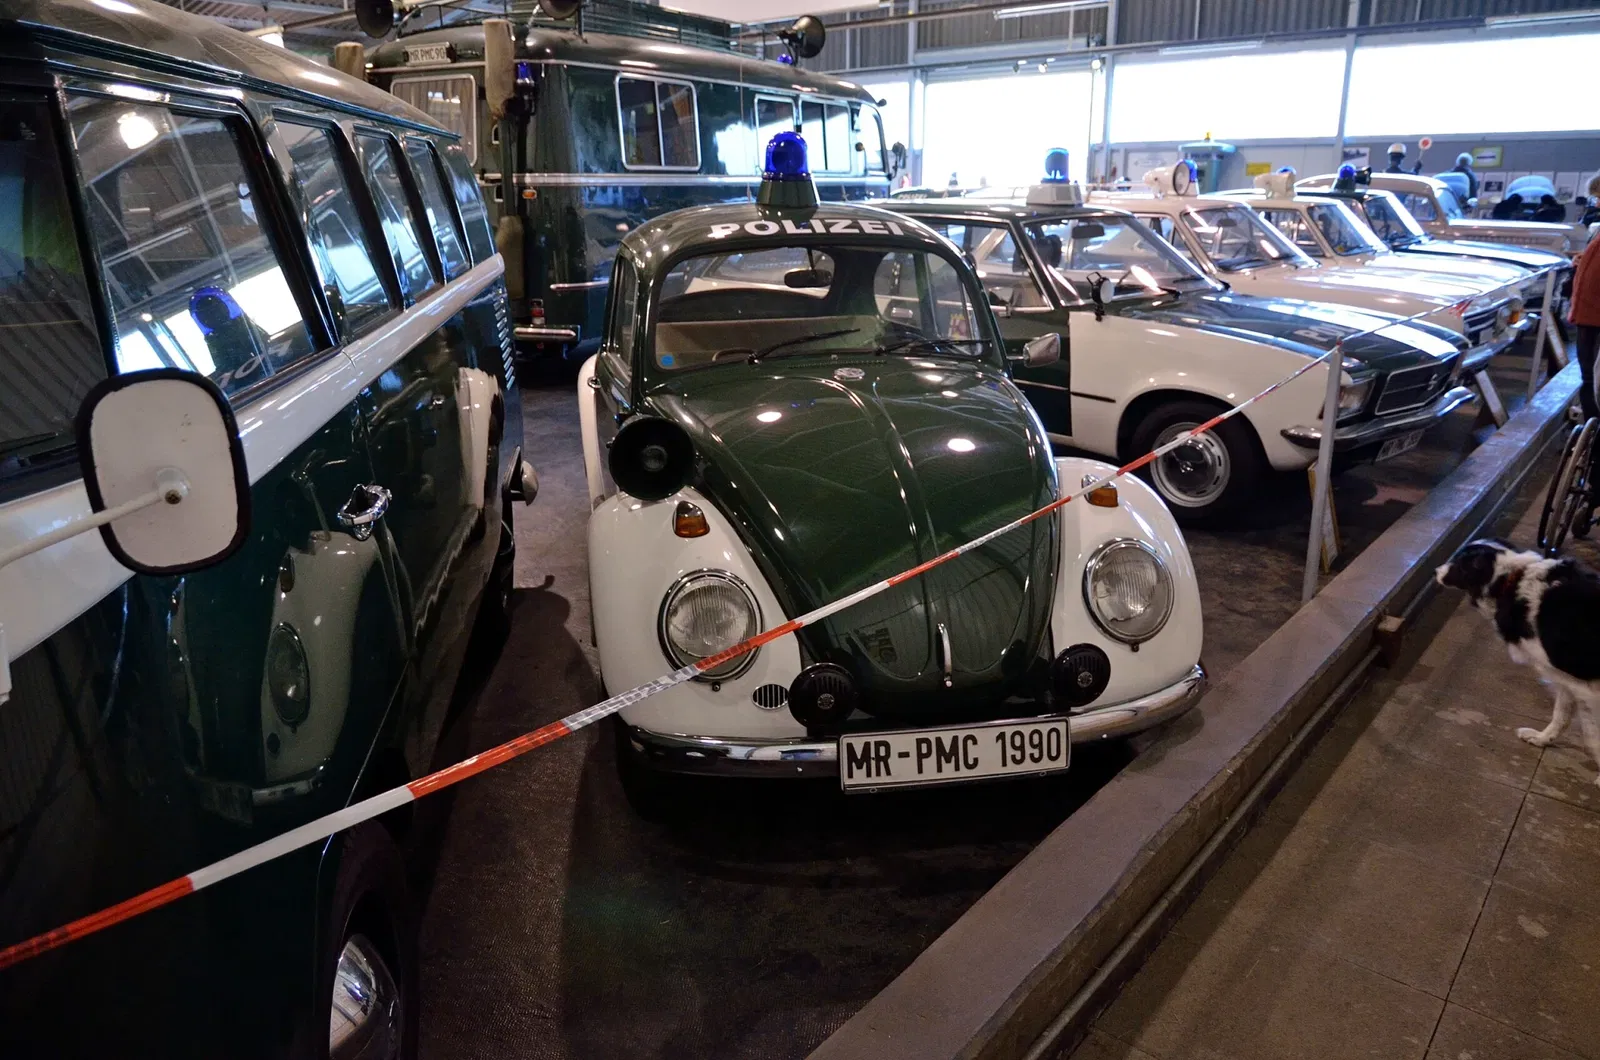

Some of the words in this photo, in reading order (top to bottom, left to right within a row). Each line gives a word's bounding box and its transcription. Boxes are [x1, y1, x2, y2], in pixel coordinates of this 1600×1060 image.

[708, 219, 905, 238] POLIZEI
[846, 734, 979, 779] MR-PMC
[995, 727, 1062, 768] 1990
